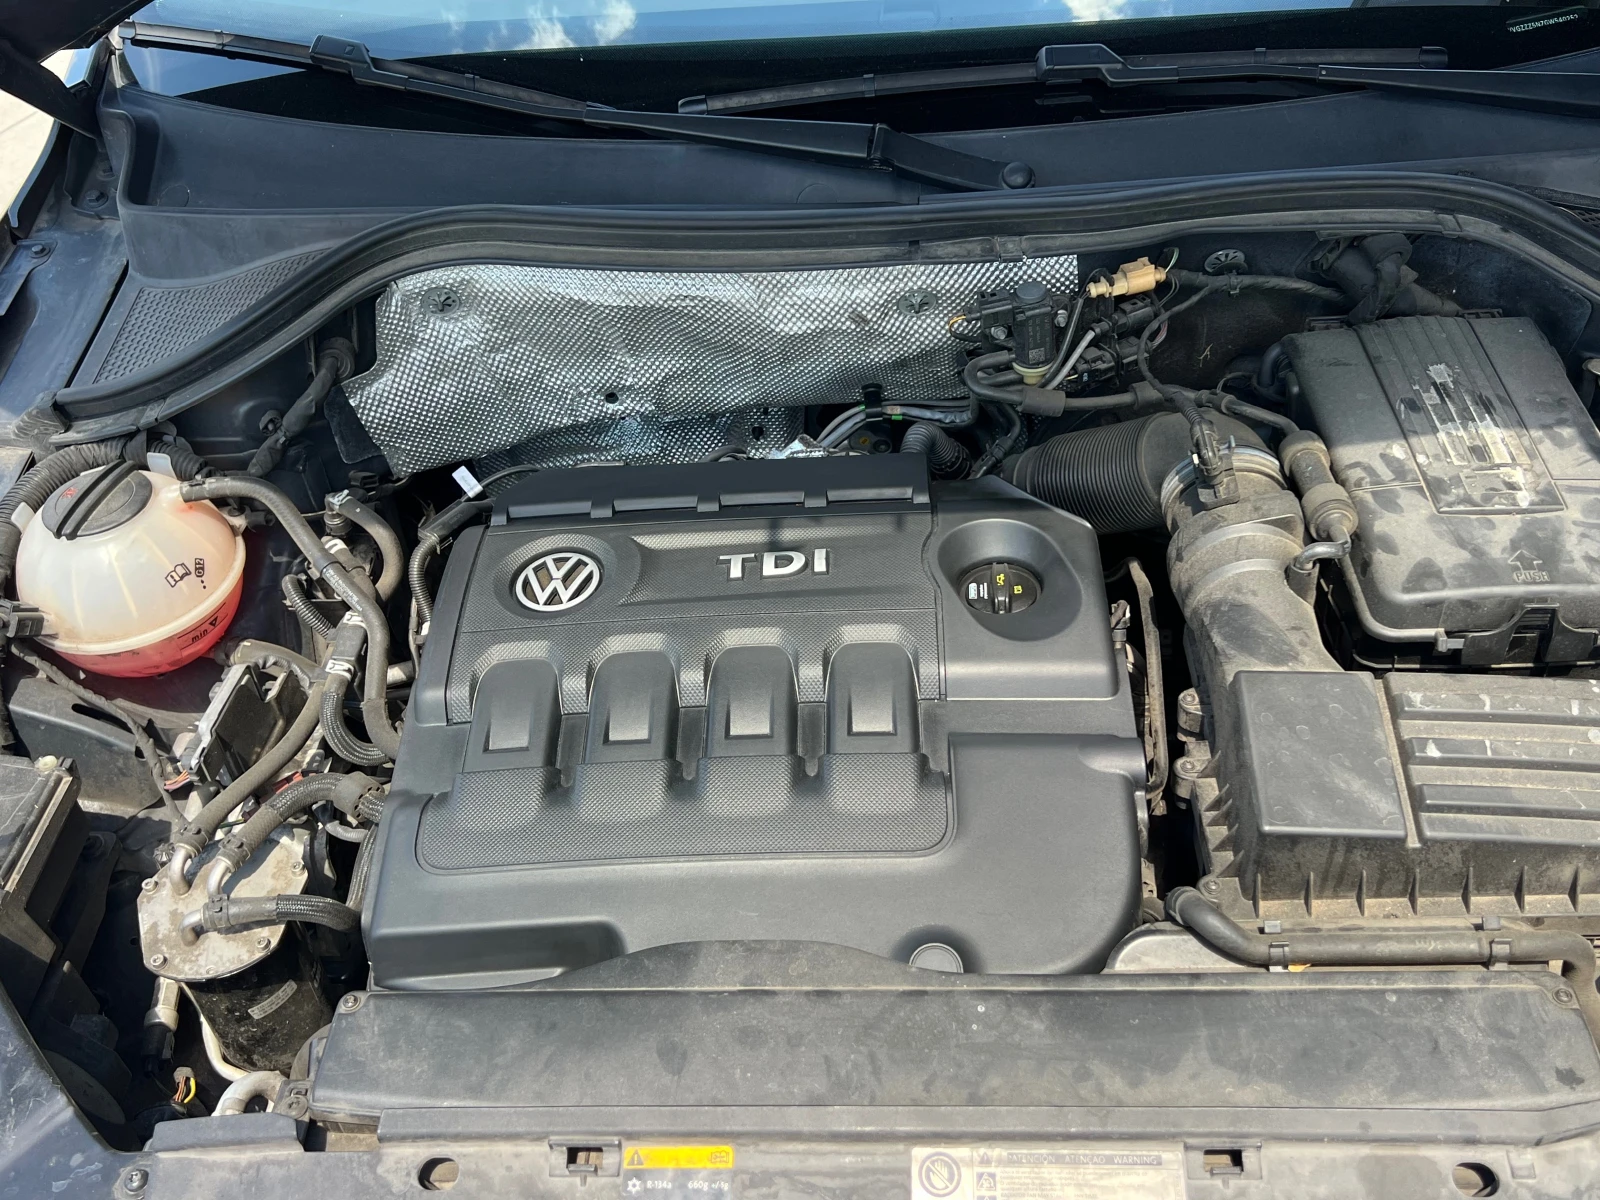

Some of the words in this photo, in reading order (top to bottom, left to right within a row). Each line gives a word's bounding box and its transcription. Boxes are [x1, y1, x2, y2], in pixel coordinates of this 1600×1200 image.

[195, 558, 204, 576] G12
[717, 548, 829, 580] TDI
[1513, 571, 1550, 582] PUSH
[191, 629, 208, 643] min
[1113, 1155, 1157, 1165] WARNING
[646, 1180, 672, 1189] R-134a
[688, 1180, 709, 1192] 660g
